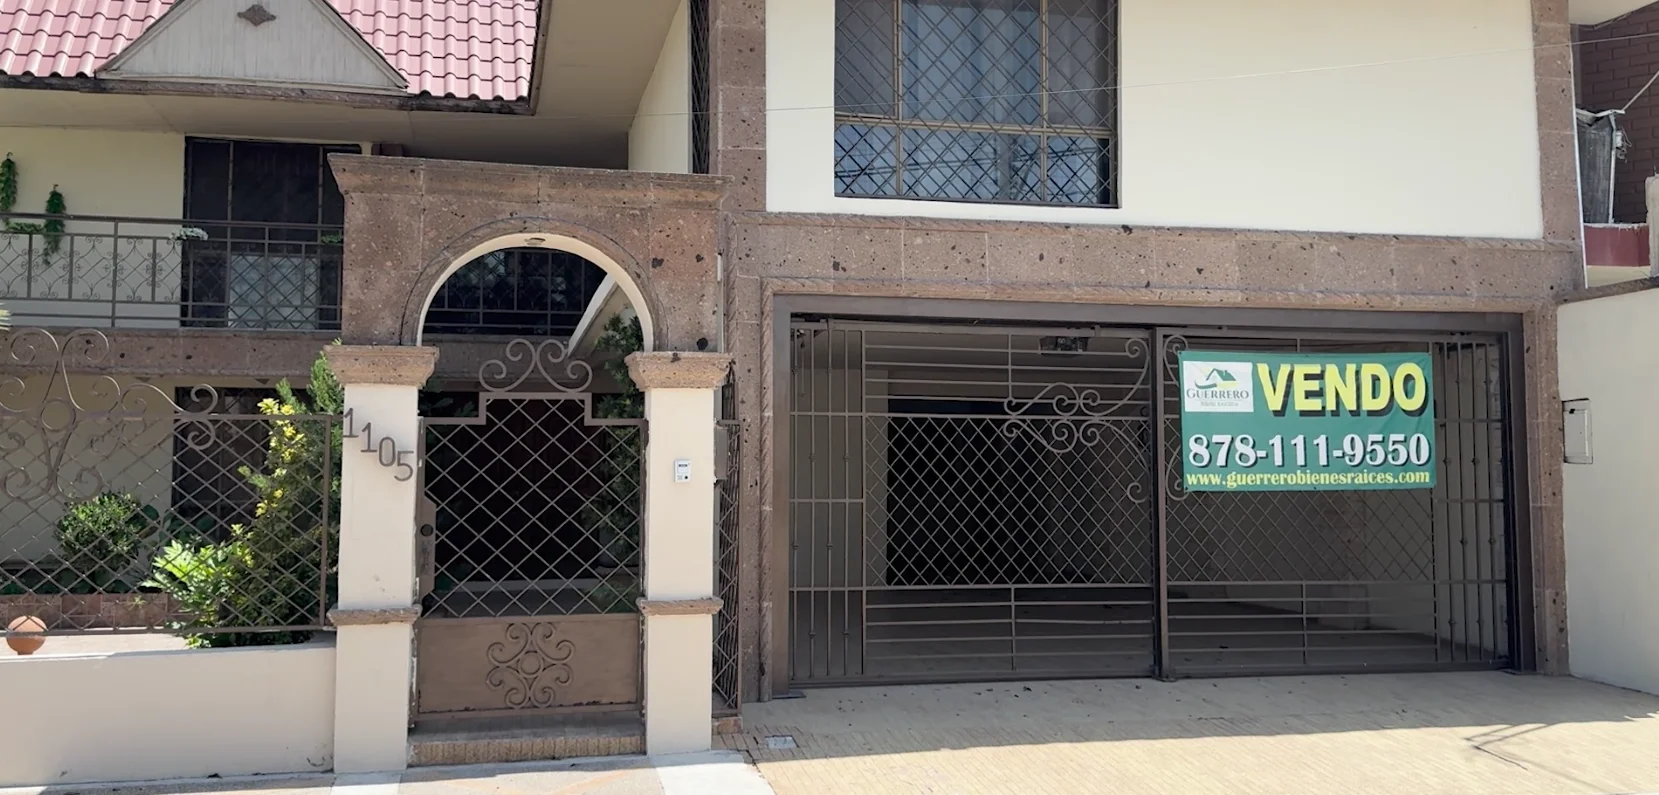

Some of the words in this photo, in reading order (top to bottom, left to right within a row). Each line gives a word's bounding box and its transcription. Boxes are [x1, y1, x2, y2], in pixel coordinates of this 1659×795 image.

[1186, 388, 1250, 399] GUERRERO
[1256, 362, 1427, 412] VENDO
[343, 407, 414, 482] 1105
[1188, 433, 1430, 467] 878-111-9550
[1186, 470, 1430, 488] www.guerrerobienesraices.com
